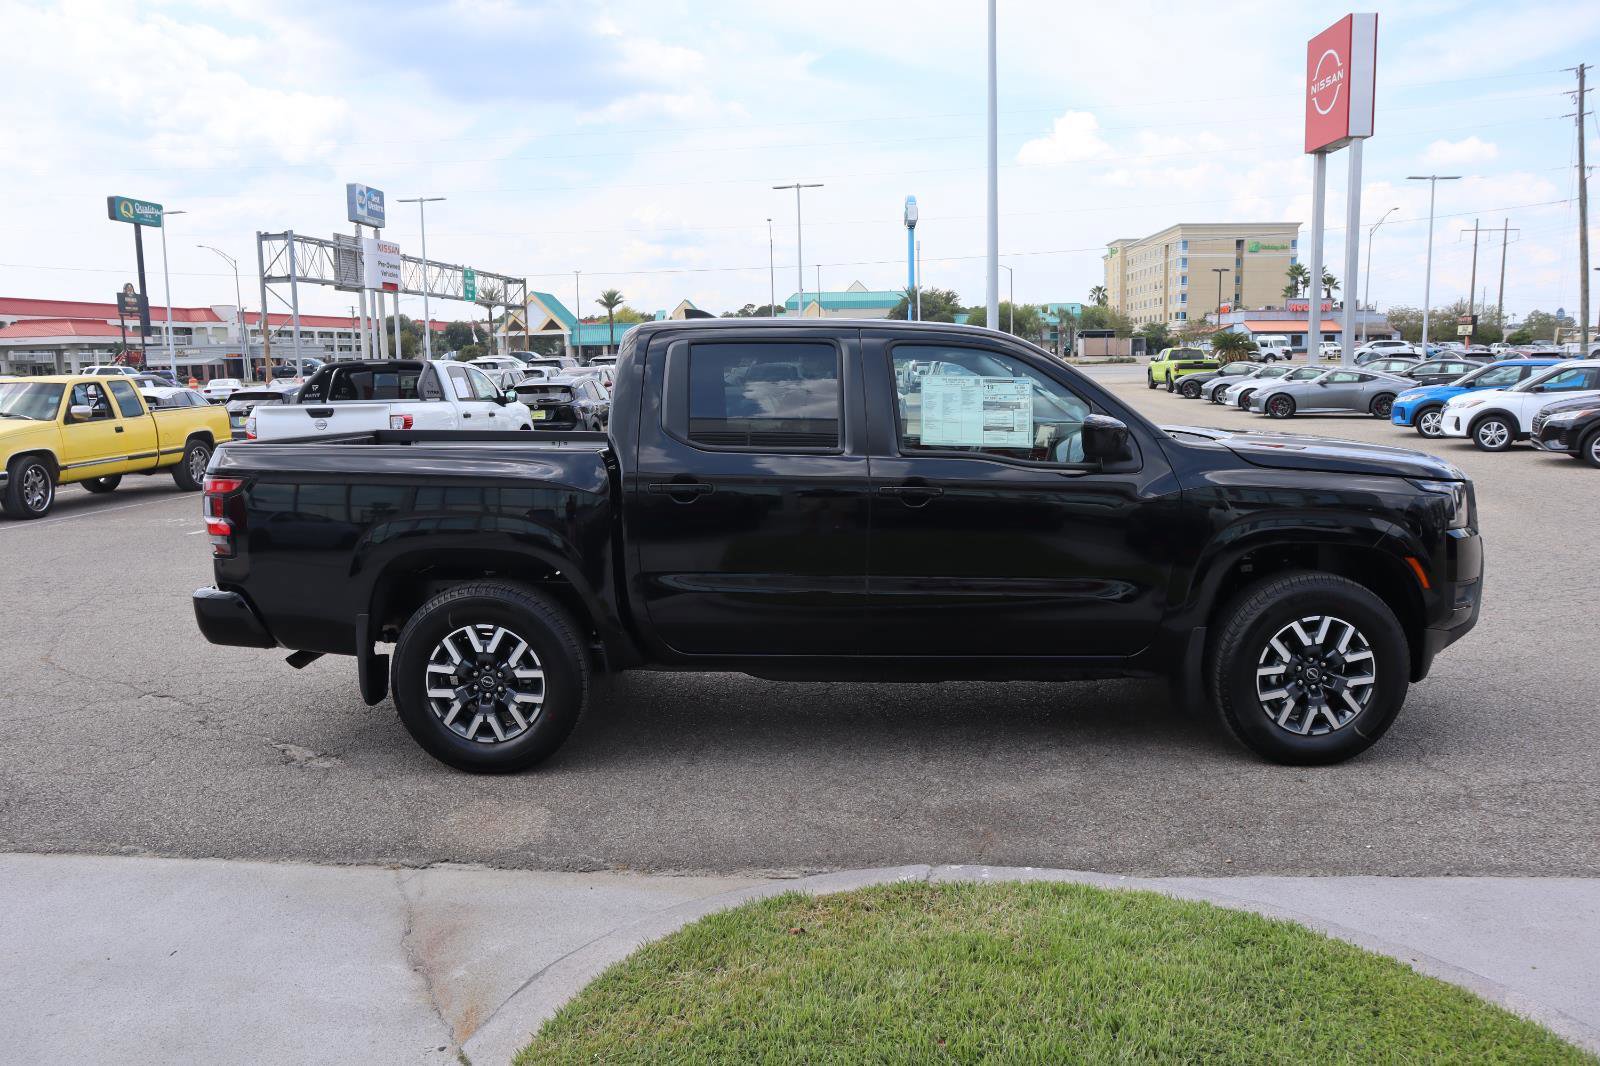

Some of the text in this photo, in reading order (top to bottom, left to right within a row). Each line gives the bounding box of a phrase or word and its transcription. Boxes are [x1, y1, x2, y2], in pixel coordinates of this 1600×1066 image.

[1310, 69, 1344, 96] NISSAN
[134, 202, 161, 217] Quality
[377, 243, 400, 256] NISSAN
[377, 260, 401, 271] Pre-Owned
